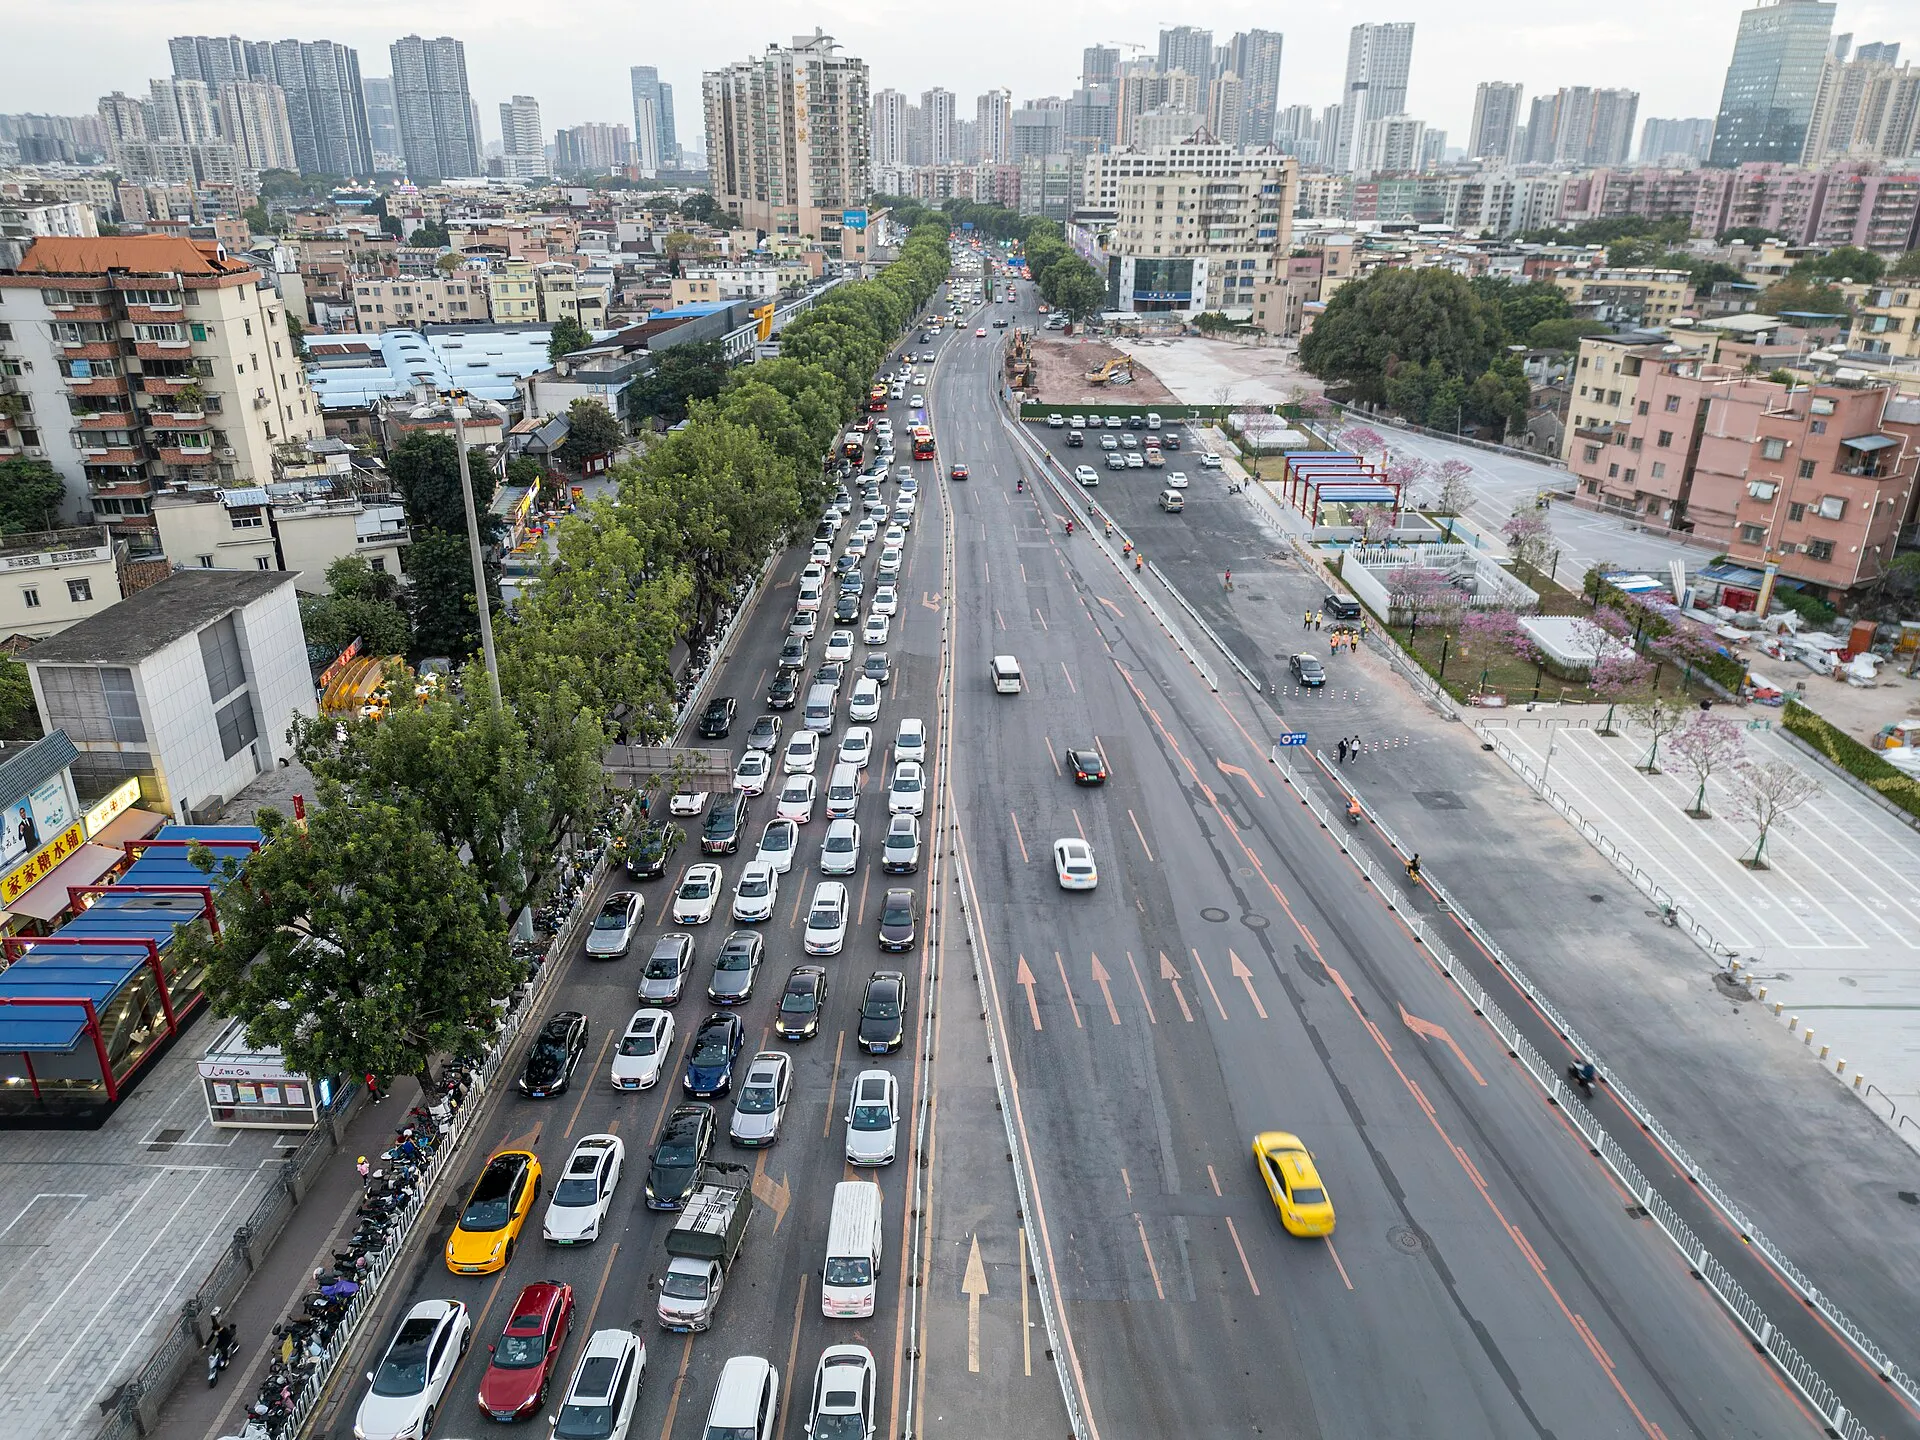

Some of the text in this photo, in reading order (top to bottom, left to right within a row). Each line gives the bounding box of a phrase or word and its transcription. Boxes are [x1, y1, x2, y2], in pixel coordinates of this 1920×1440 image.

[7, 829, 79, 897] 家家糖水铺
